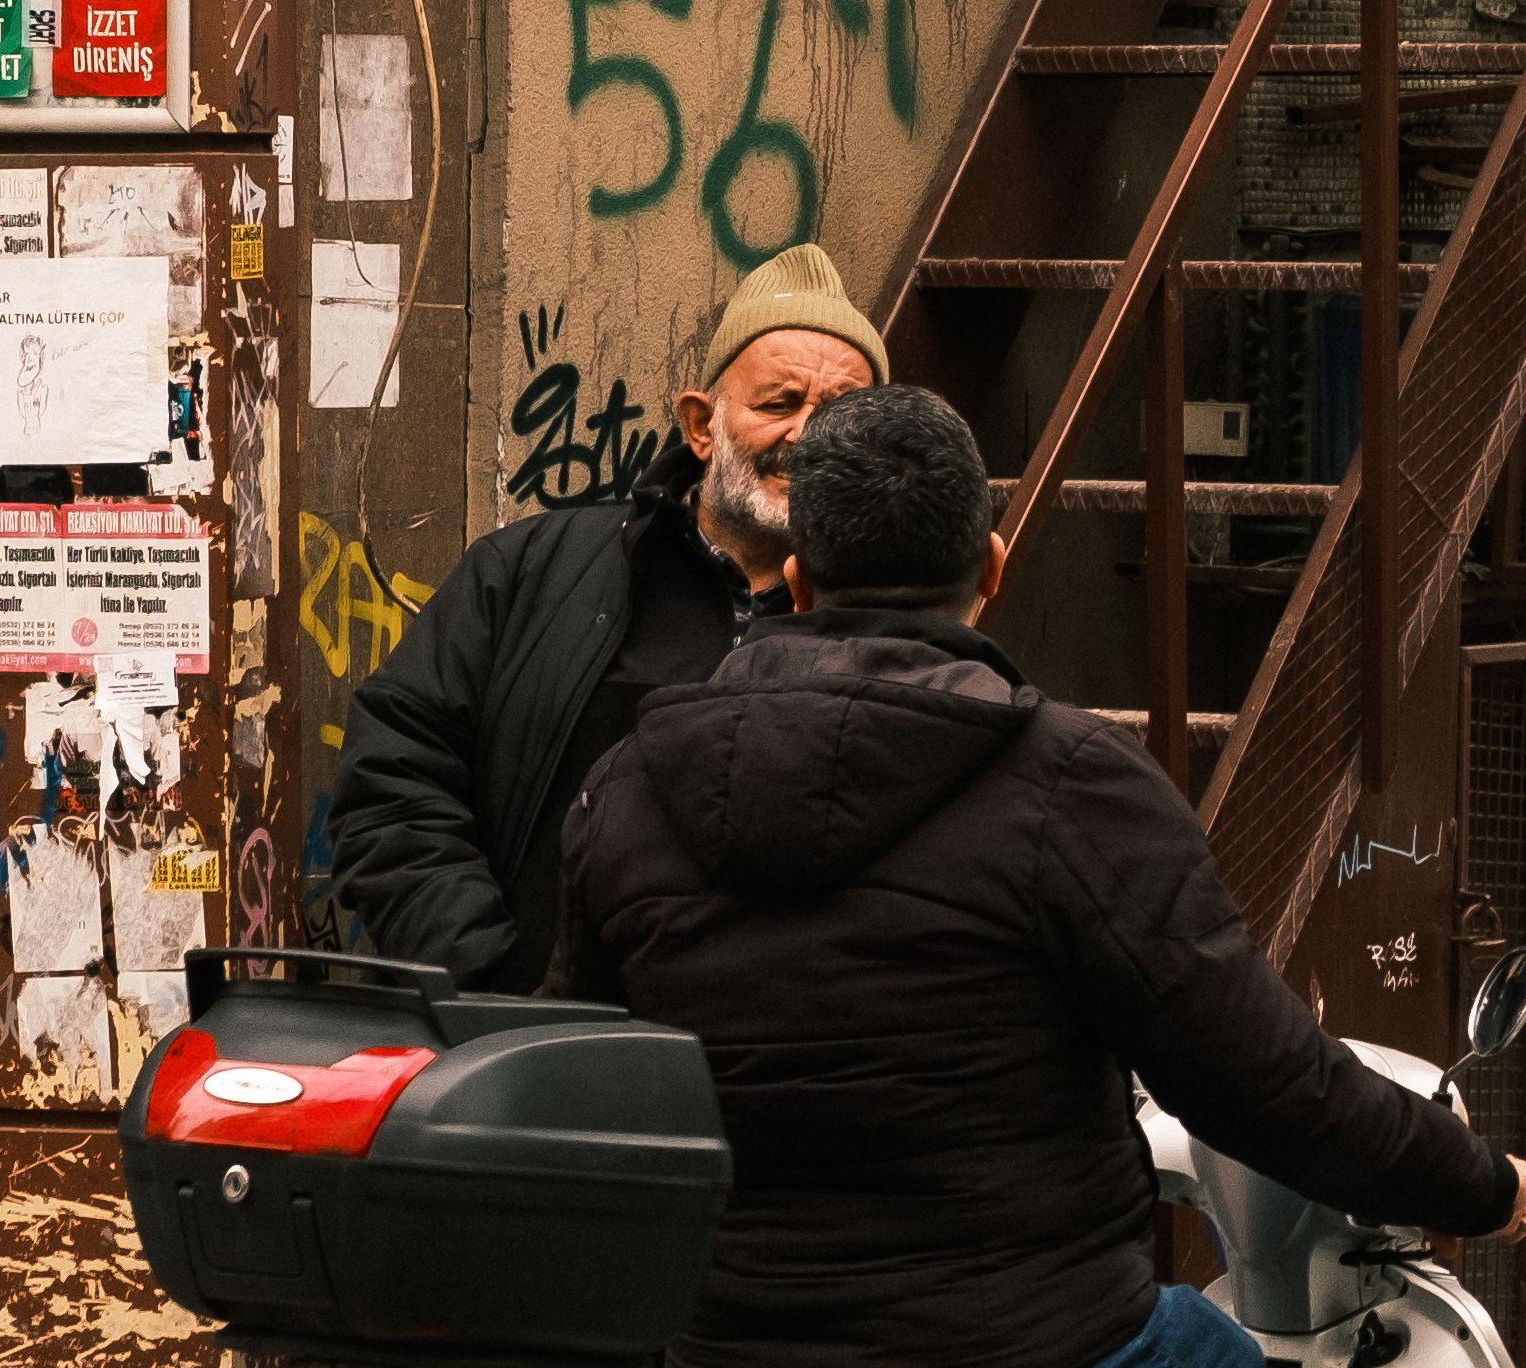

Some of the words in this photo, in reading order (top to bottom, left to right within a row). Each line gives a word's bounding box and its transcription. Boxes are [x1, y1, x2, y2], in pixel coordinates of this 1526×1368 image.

[87, 8, 139, 38] İZZET
[0, 54, 22, 82] ET
[73, 45, 154, 83] DİRENİŞ
[48, 309, 95, 325] LÜTFEN
[67, 507, 119, 533] REAKSİYON
[120, 509, 162, 533] NAKLİYAT
[67, 546, 83, 563] Her
